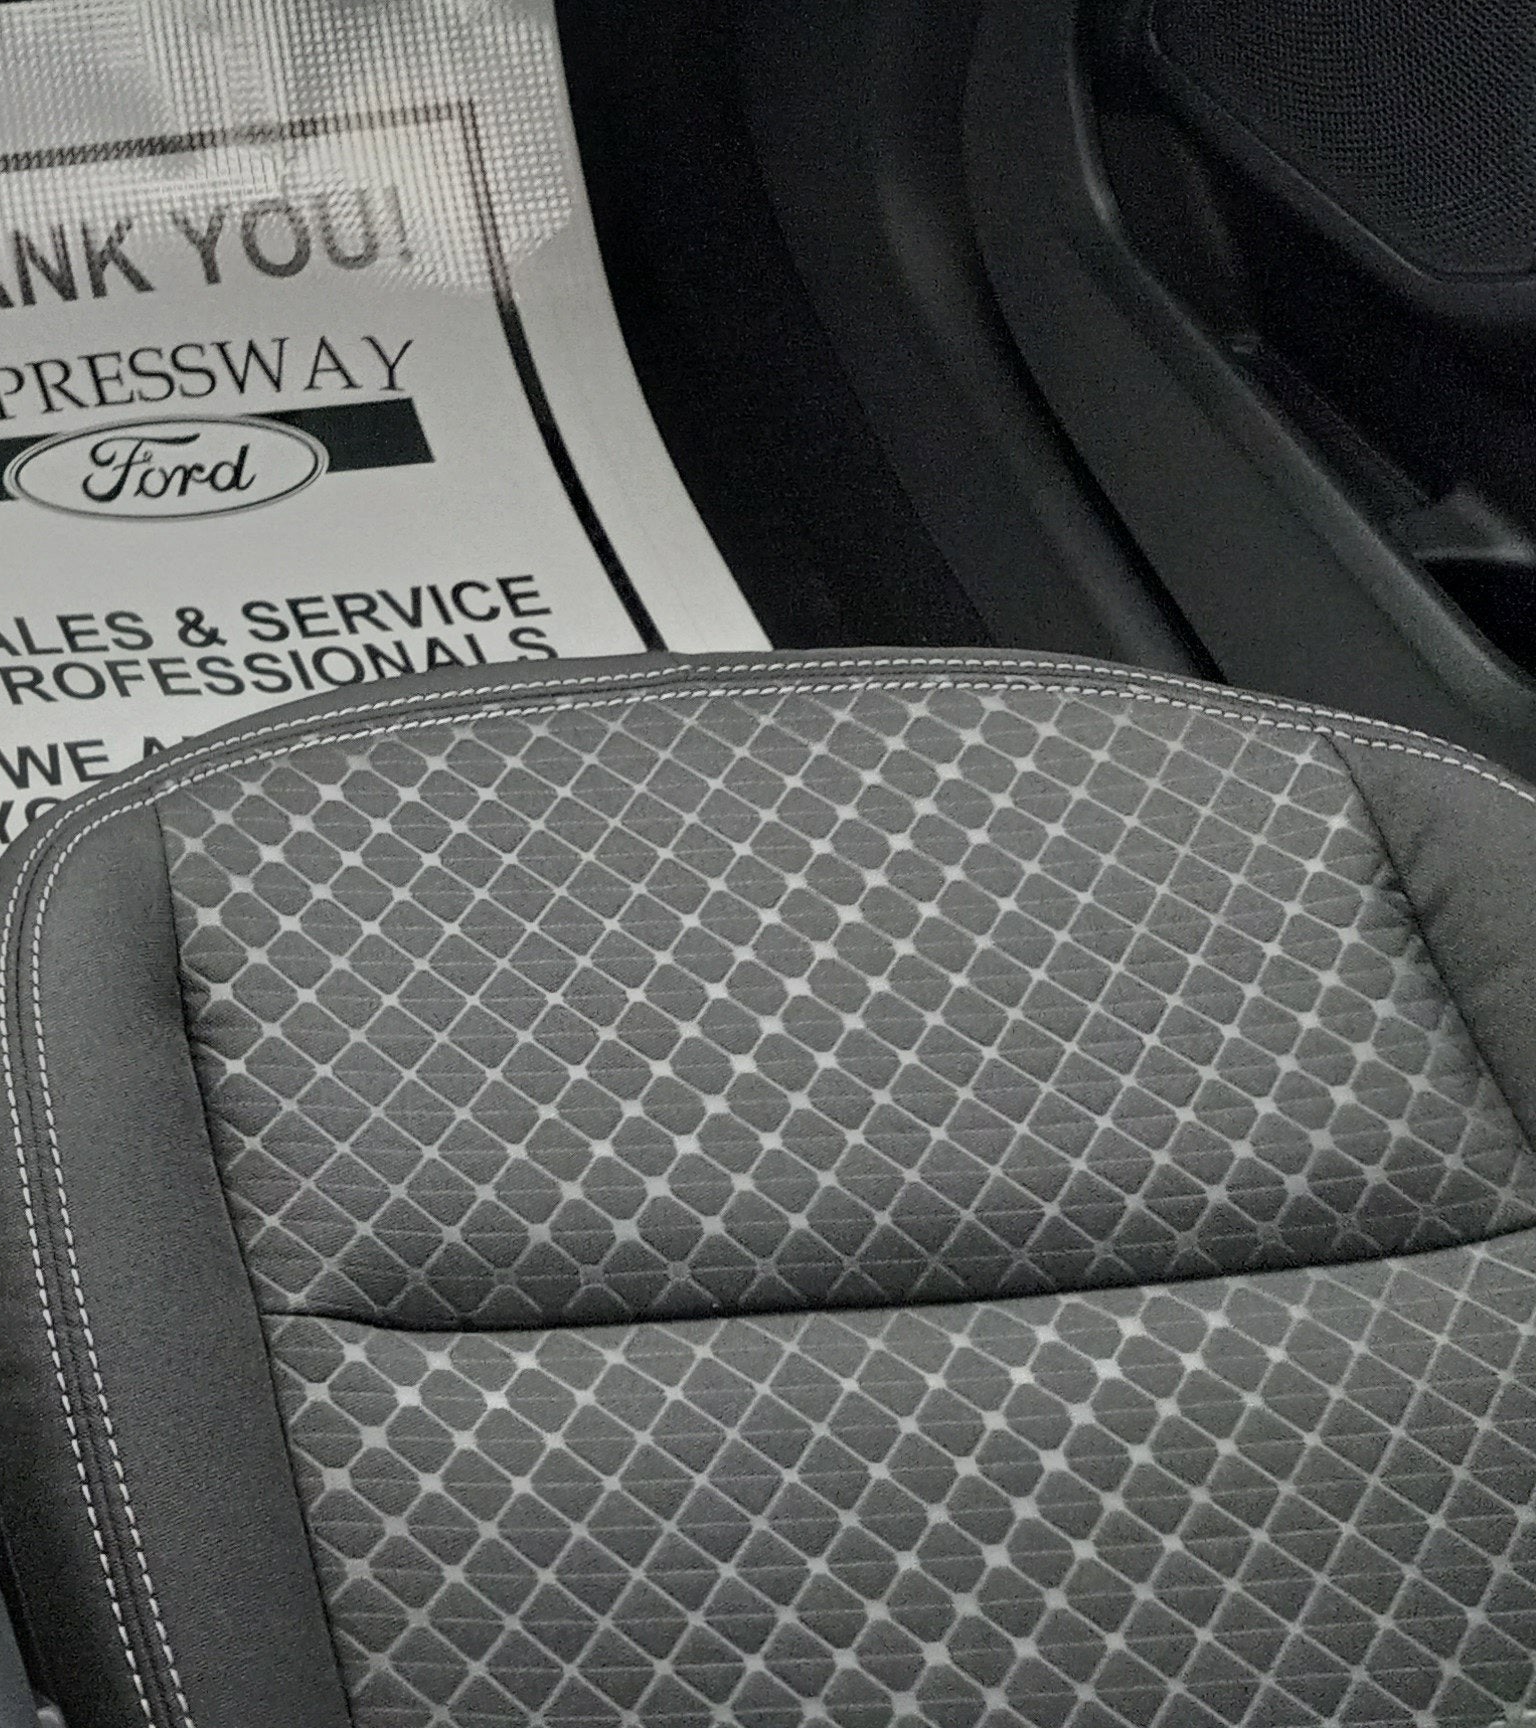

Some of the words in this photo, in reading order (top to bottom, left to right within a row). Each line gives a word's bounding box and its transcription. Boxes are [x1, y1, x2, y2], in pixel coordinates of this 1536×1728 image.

[170, 182, 418, 288] YOU!
[80, 432, 257, 505] Ford
[175, 605, 228, 647] &
[240, 574, 553, 643] SERVICE
